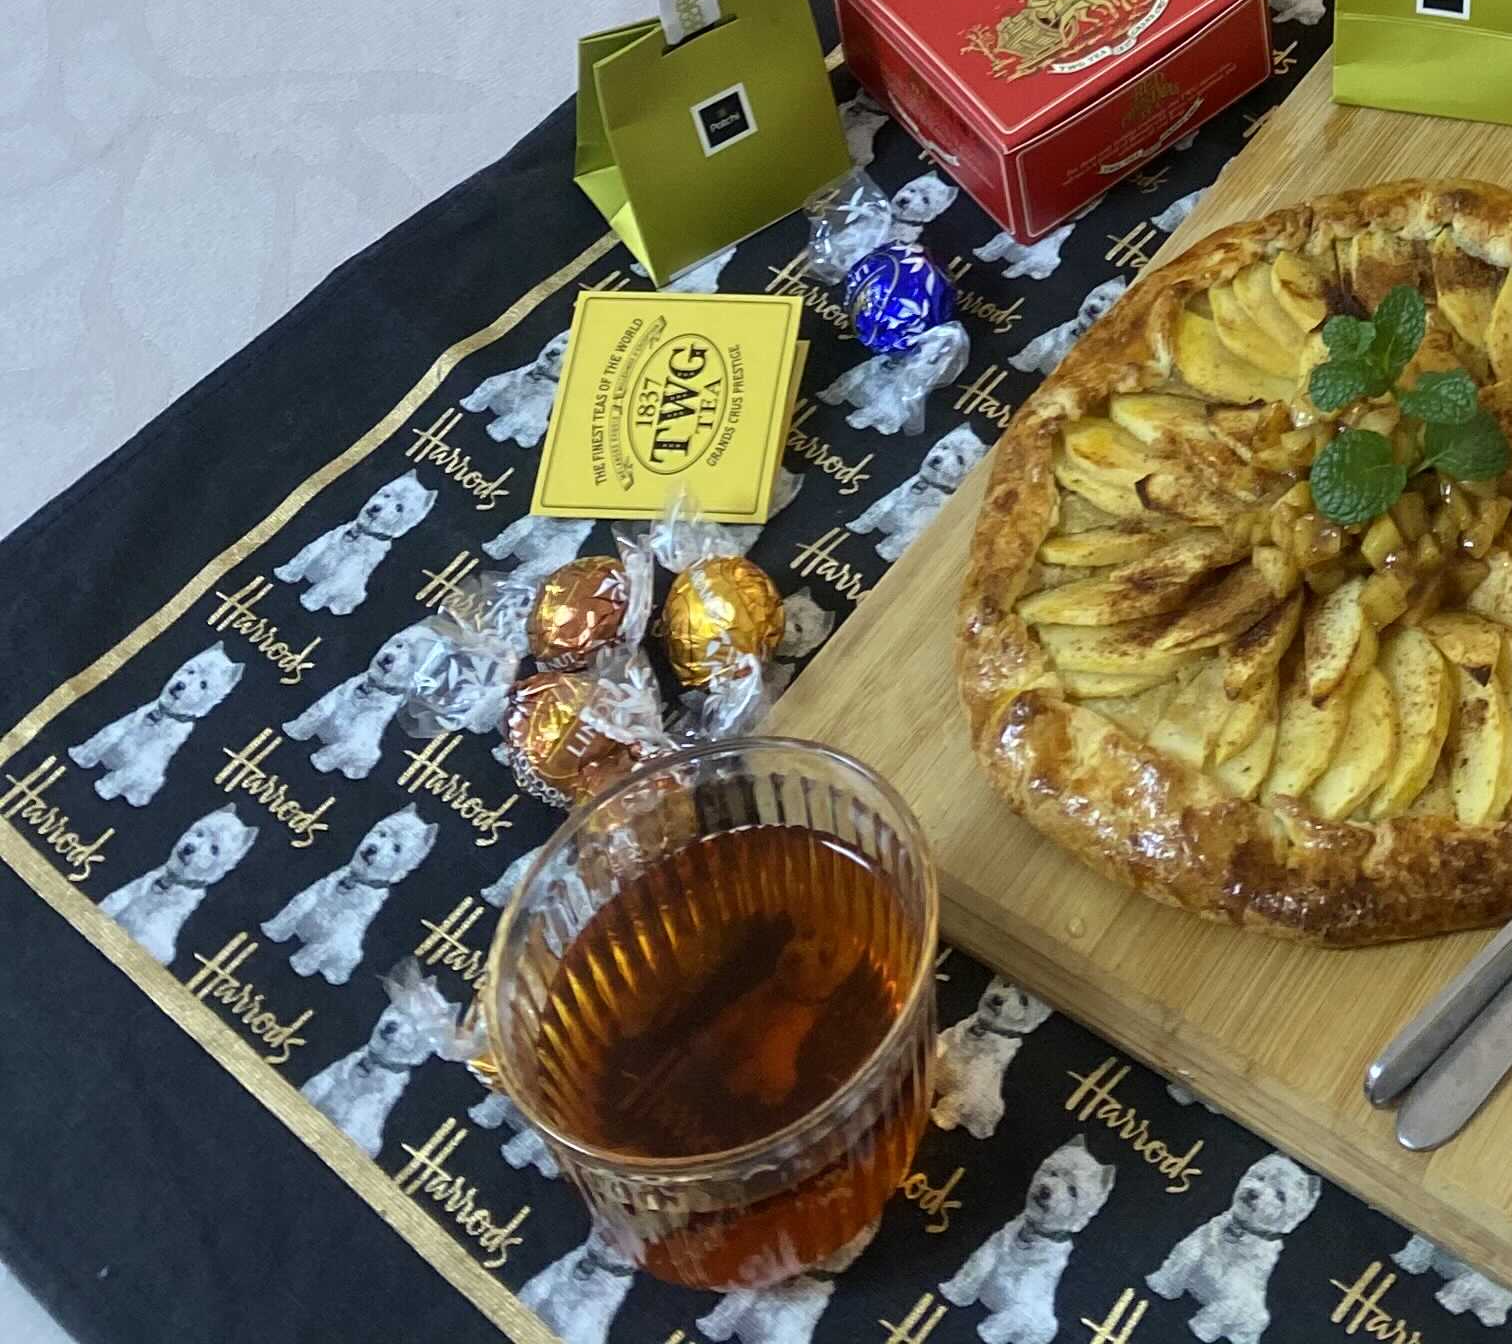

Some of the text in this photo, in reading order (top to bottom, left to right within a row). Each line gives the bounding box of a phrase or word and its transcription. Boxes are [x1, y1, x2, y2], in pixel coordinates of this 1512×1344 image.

[405, 407, 514, 511] Harrods
[592, 317, 644, 485] THE FINEST TEAS OF THE WORLD
[636, 377, 664, 428] 1837
[650, 343, 710, 464] TWG
[694, 378, 722, 435] TEA
[706, 343, 745, 468] GRANDS CRUS PRESTIGE
[789, 527, 876, 601] Harr
[206, 575, 323, 686] Harrods
[0, 755, 116, 883] Harrods
[214, 727, 337, 848] Harrods
[396, 732, 521, 847] Harrods
[184, 931, 314, 1065] Harrods
[414, 895, 490, 992] Harr
[1065, 1056, 1205, 1194] Harrods
[395, 1117, 531, 1269] Harrods
